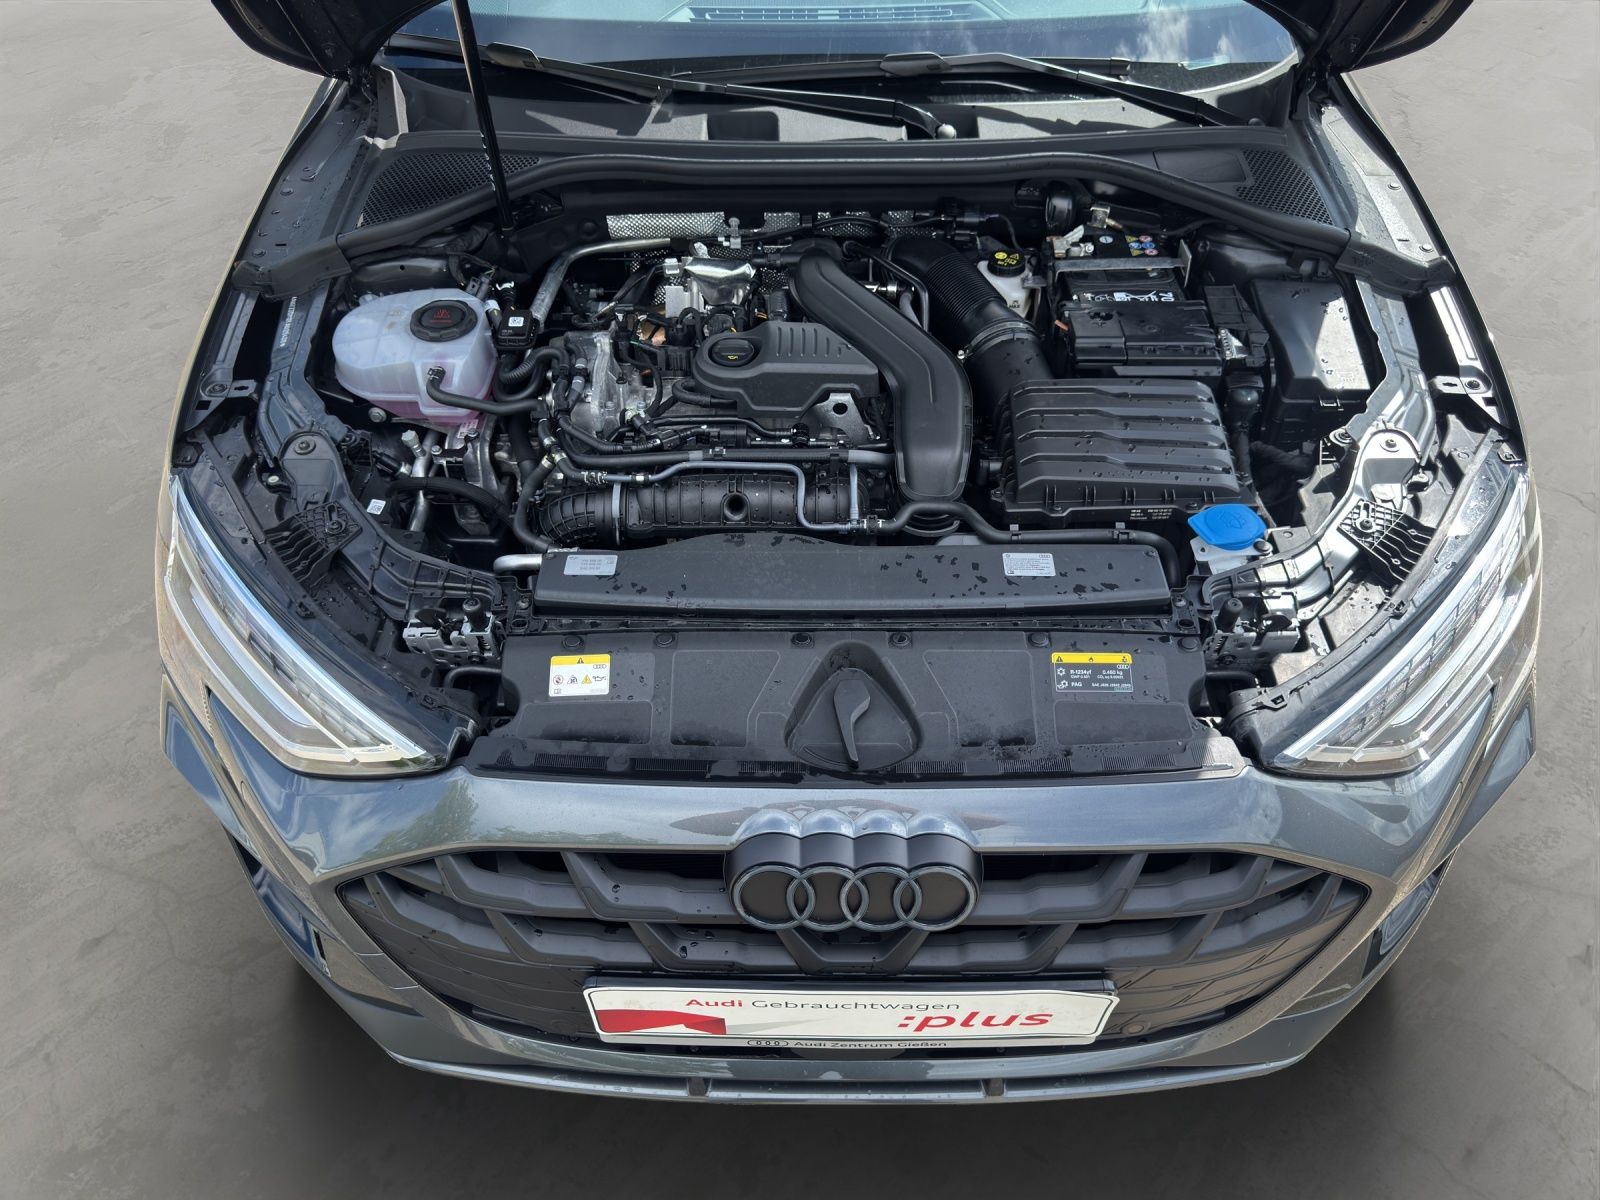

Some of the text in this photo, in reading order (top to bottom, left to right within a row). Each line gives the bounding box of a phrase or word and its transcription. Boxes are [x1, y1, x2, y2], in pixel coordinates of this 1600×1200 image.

[686, 999, 961, 1012] Audi Gebrauchtwagen
[897, 1011, 1054, 1033] :plus
